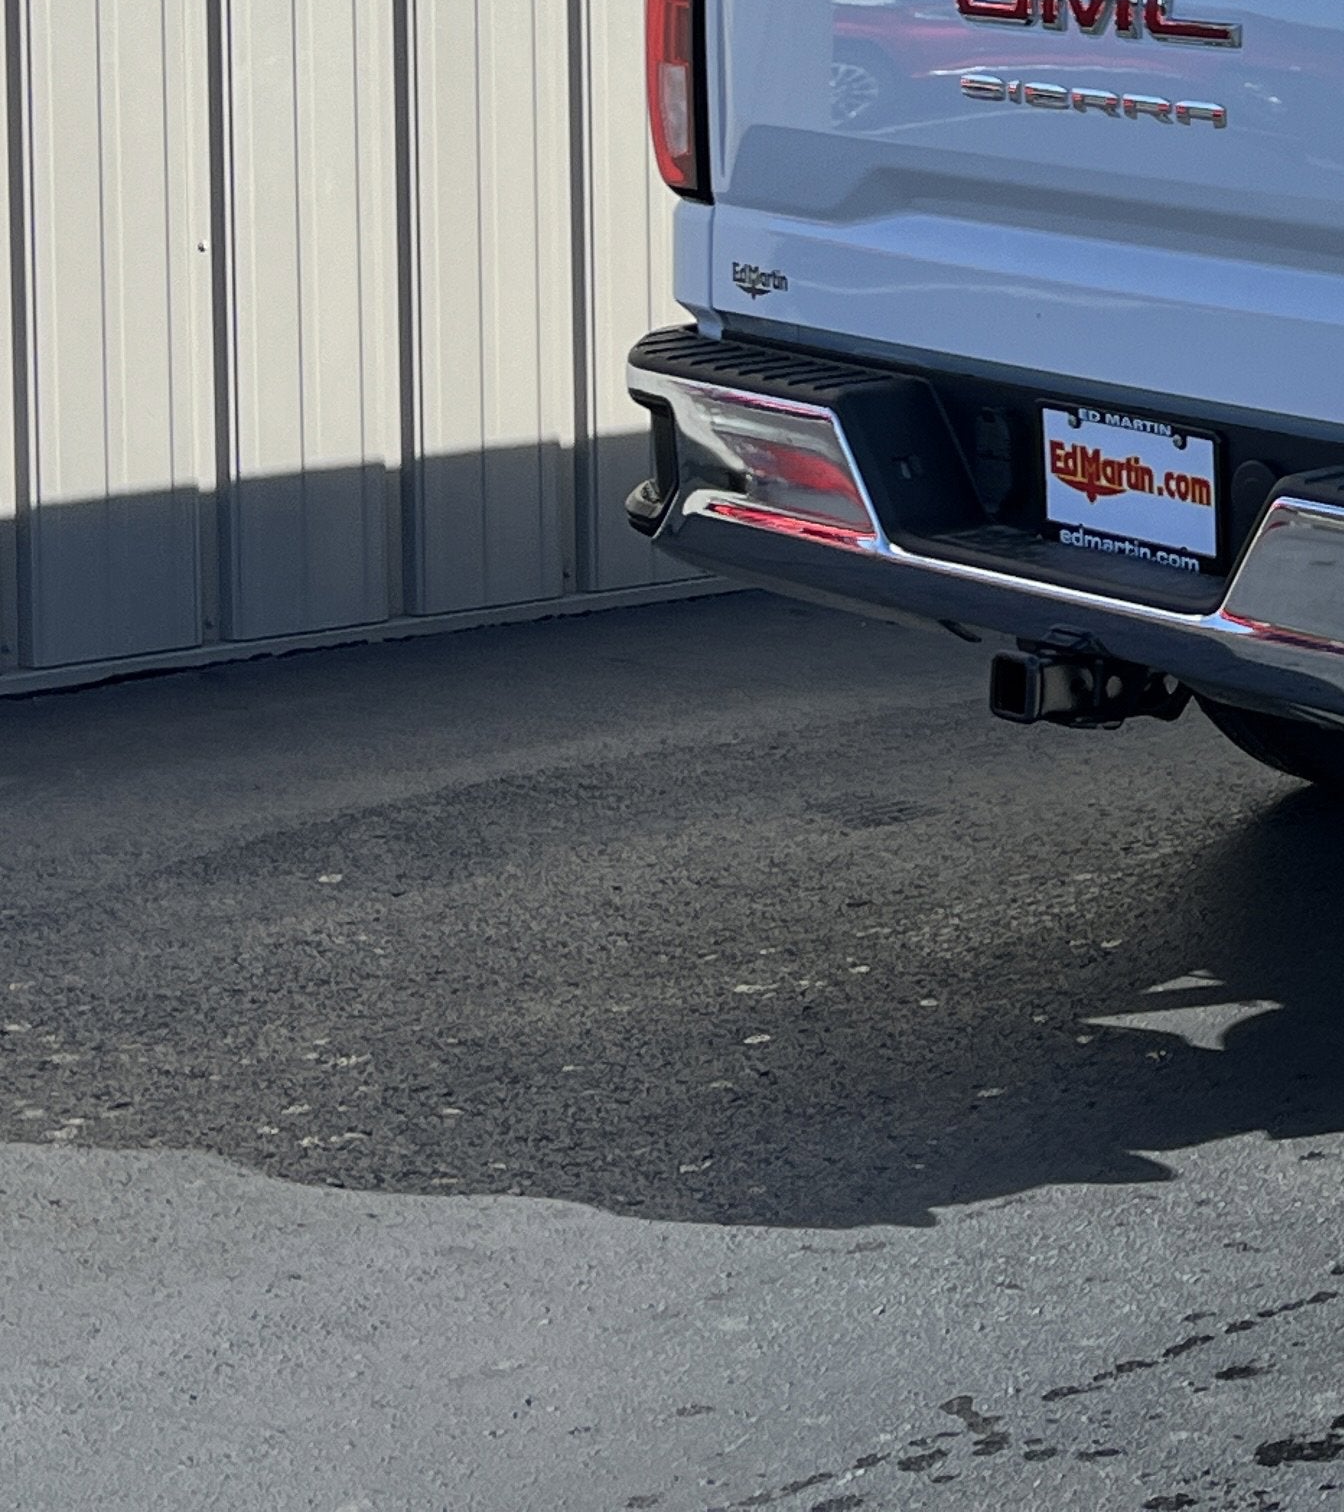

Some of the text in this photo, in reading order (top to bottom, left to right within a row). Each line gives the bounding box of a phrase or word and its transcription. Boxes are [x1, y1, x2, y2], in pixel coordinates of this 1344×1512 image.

[959, 74, 1228, 129] SIERRA
[1077, 407, 1172, 437] ED MARTIN
[1049, 439, 1213, 507] EdMartin.com
[1058, 526, 1200, 573] edmartin.com
